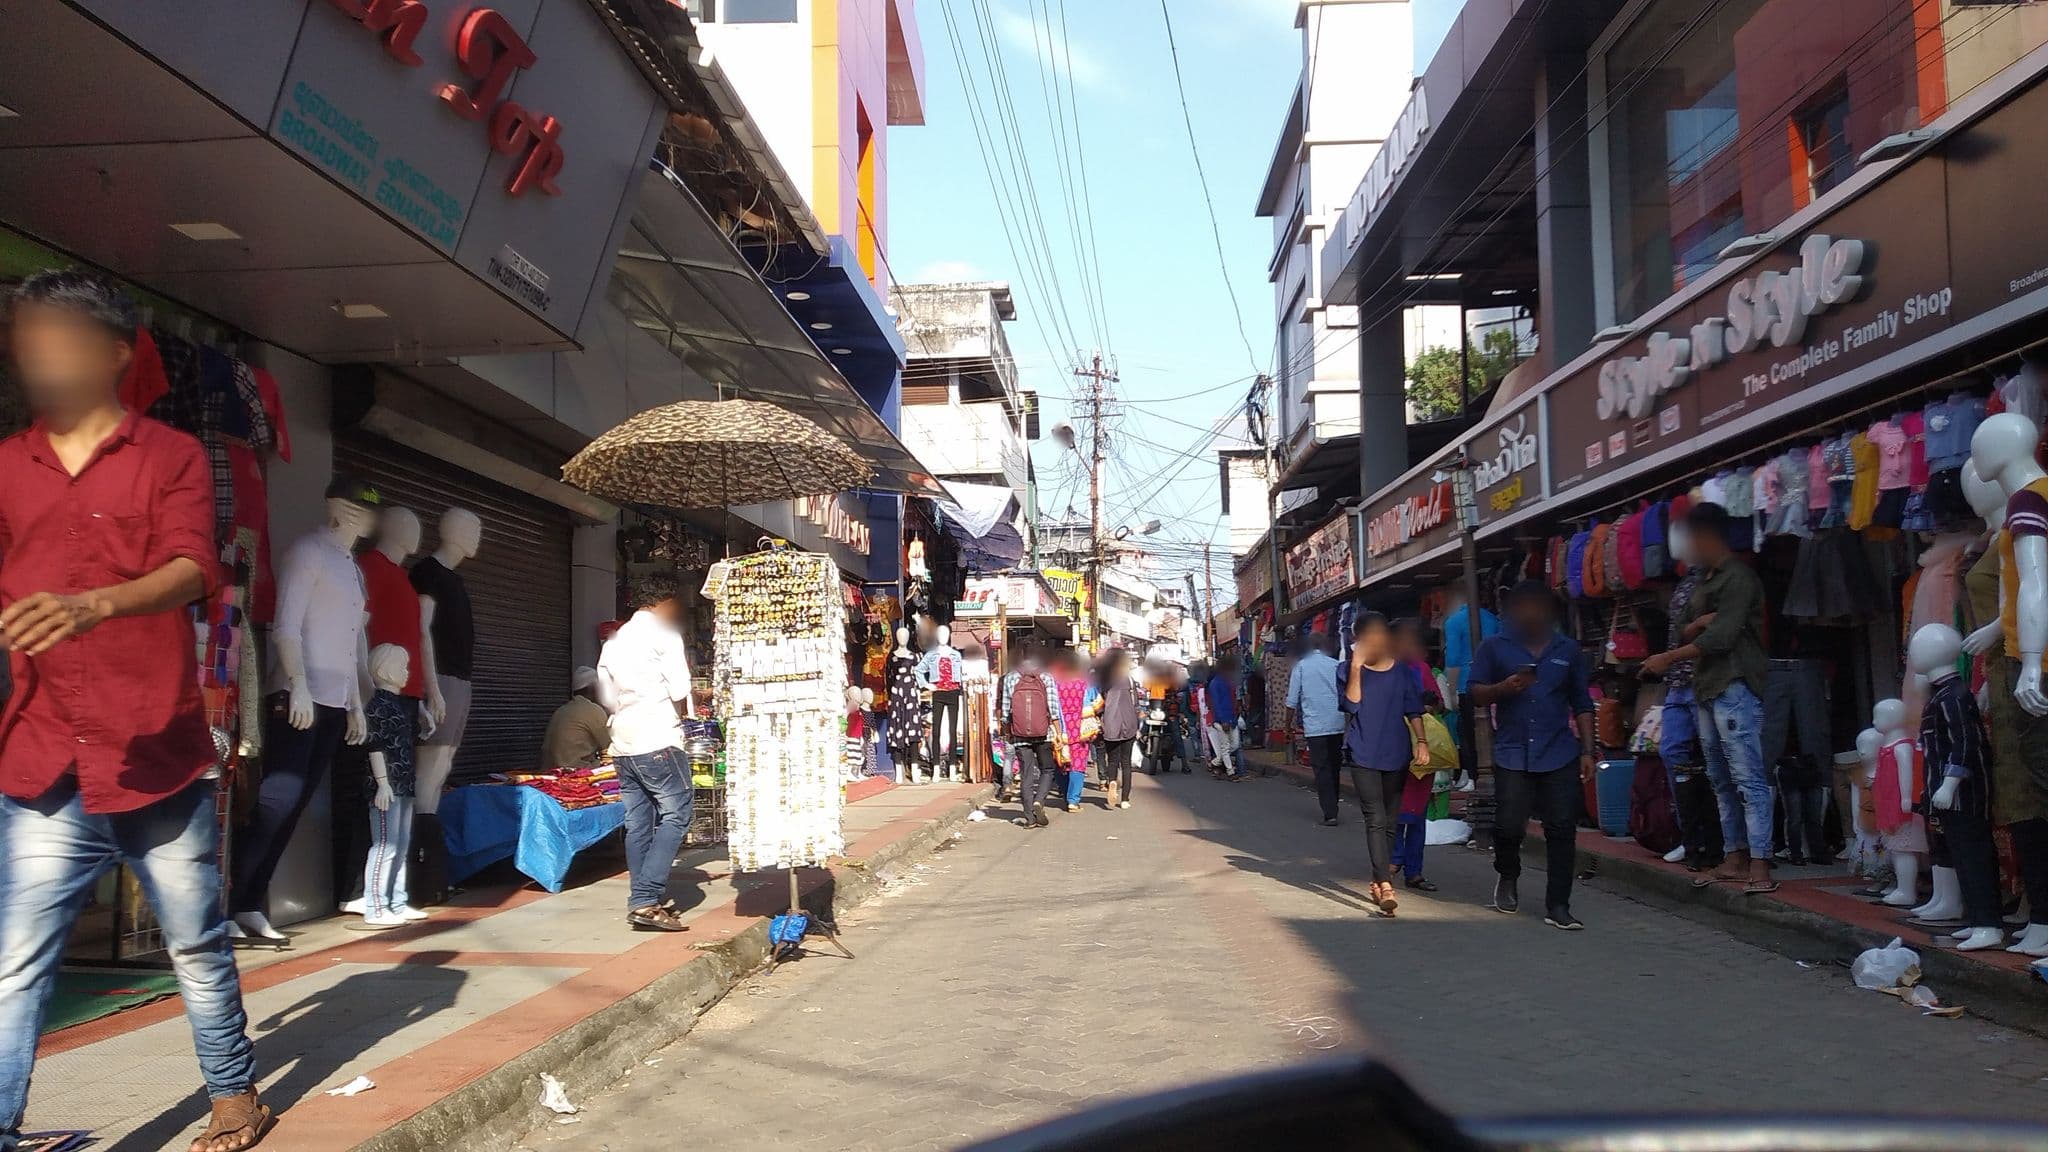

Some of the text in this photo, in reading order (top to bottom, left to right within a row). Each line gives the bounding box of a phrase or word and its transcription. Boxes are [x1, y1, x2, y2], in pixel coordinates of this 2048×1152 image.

[1596, 332, 1690, 420] Style
[1725, 234, 1863, 353] Style
[1742, 287, 1952, 397] The Complete Family Shop
